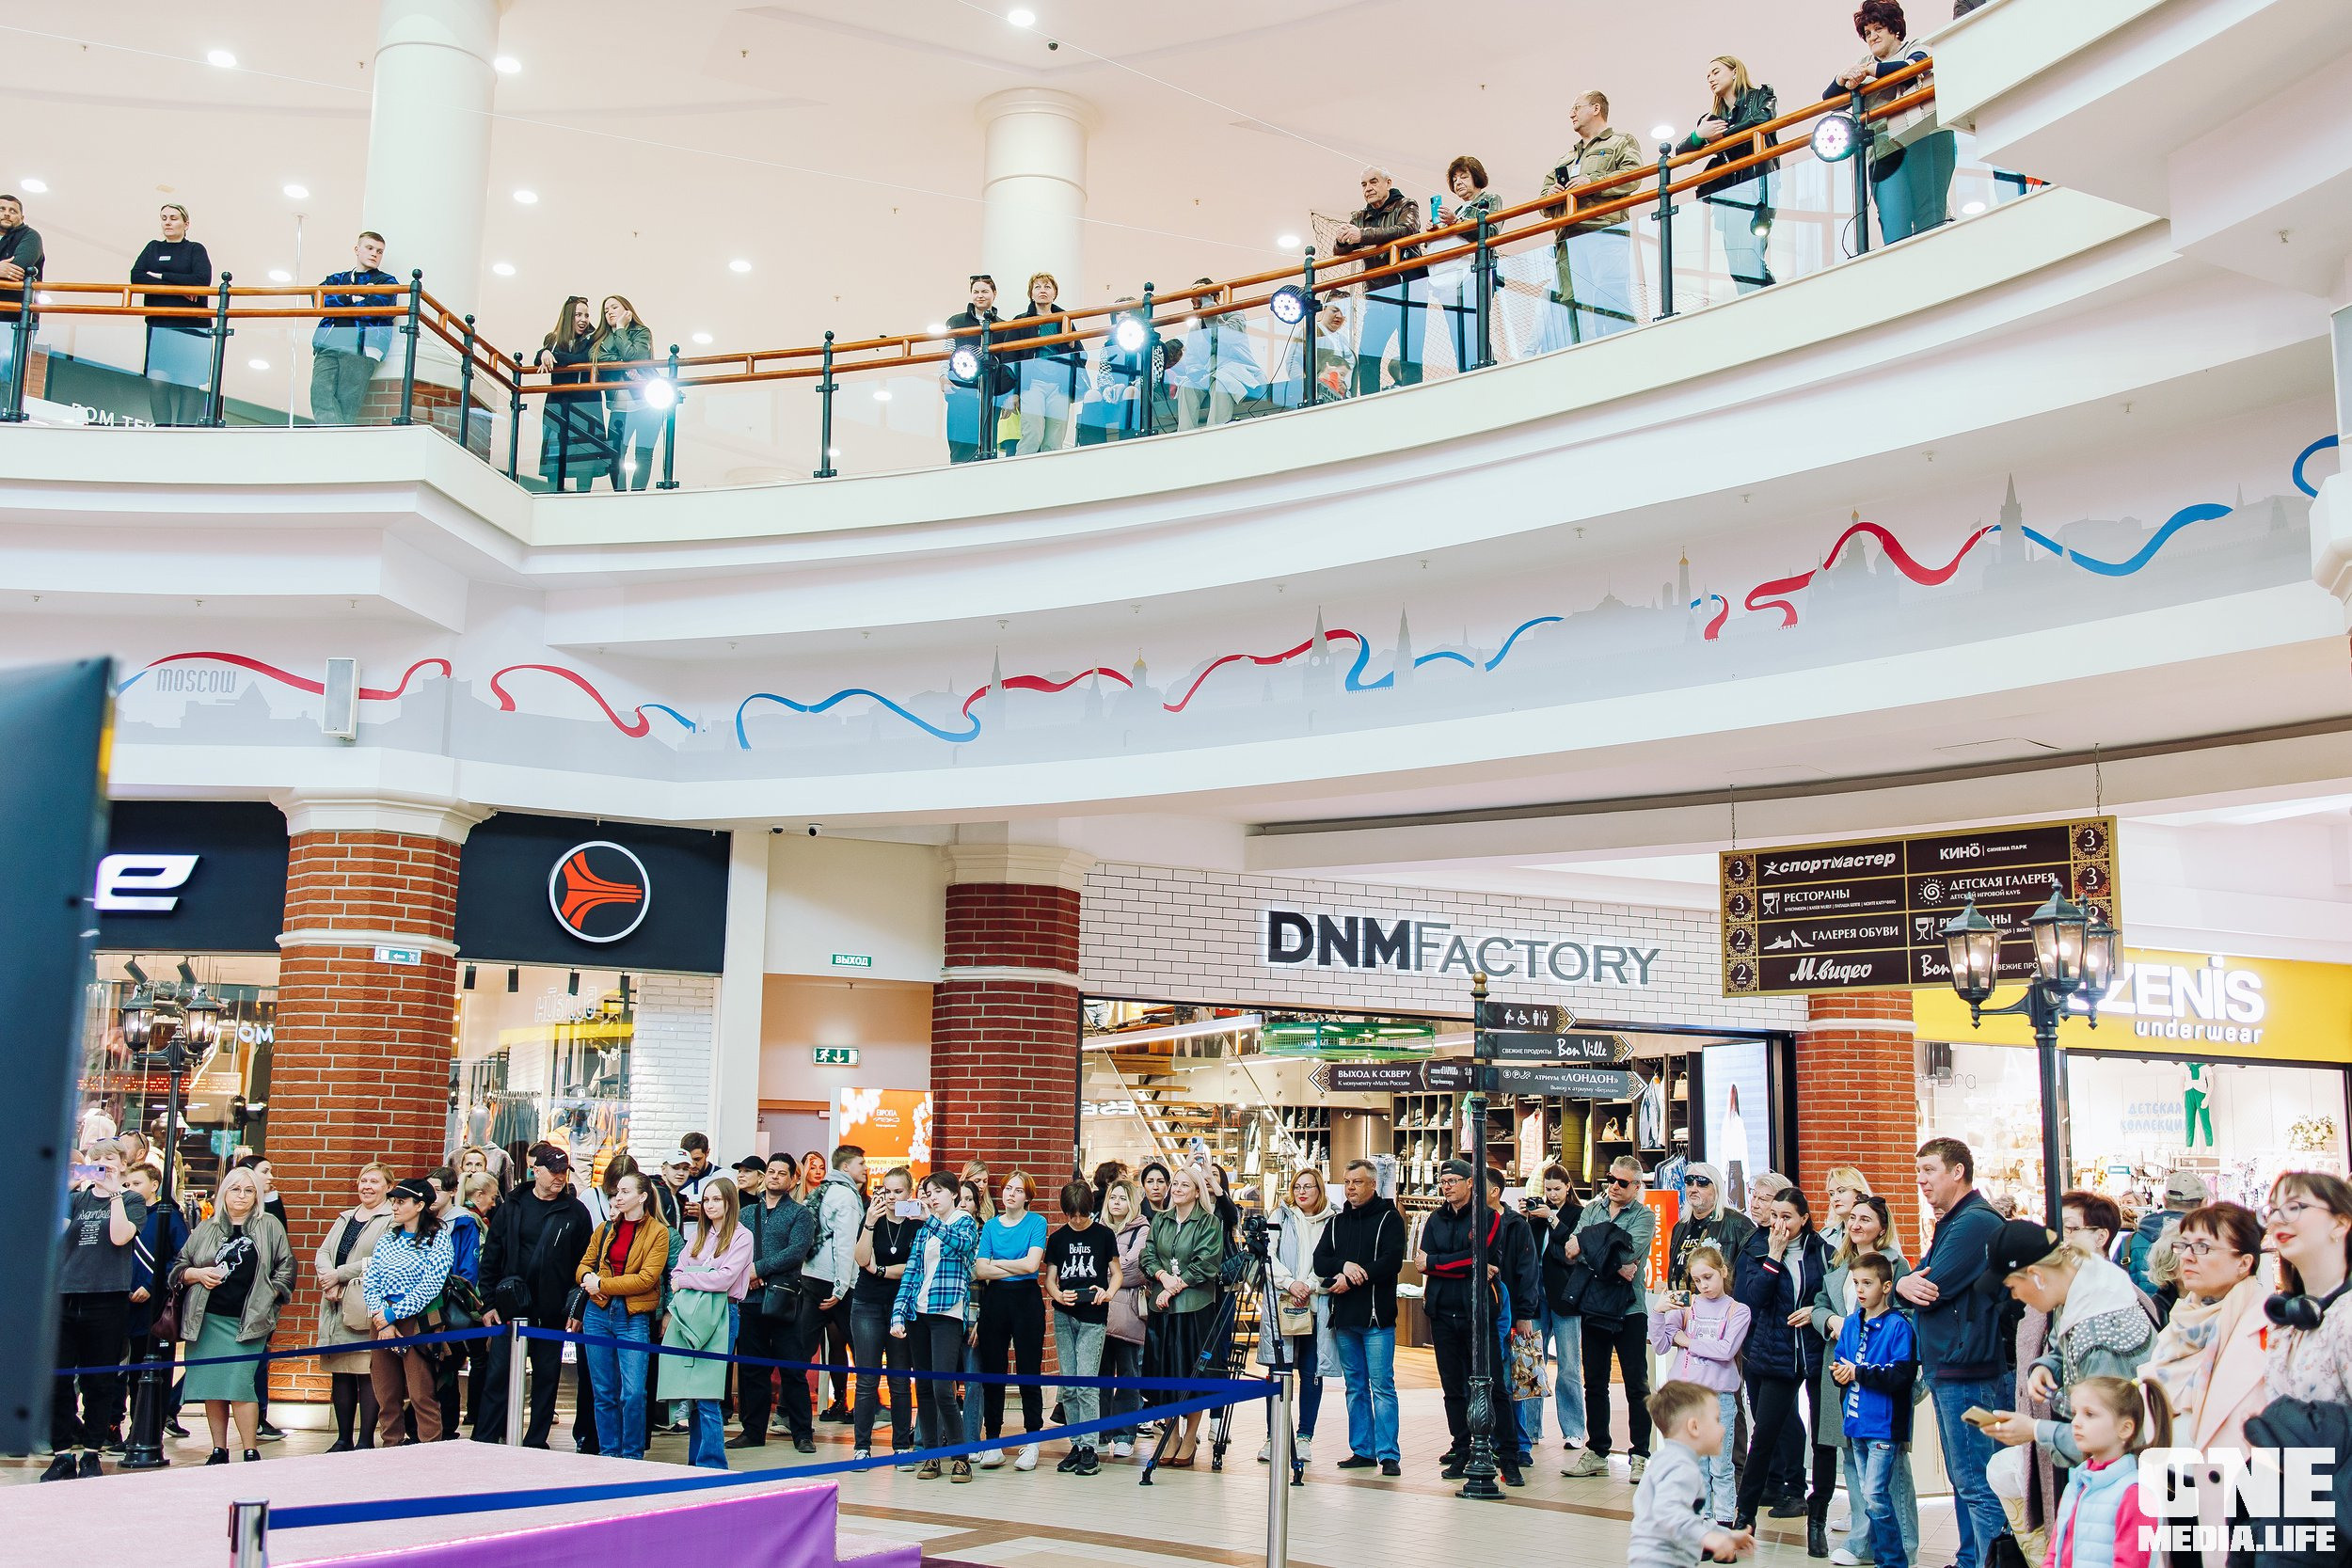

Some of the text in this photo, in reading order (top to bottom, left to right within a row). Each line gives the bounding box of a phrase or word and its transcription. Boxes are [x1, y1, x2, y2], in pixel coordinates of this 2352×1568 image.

[156, 668, 237, 693] MOSCOW
[2084, 829, 2095, 847] 3
[1734, 861, 1744, 877] 3
[2086, 867, 2097, 885] 3
[1949, 872, 2056, 891] ДЕТСКАЯ ГАЛЕРЕЯ
[1735, 895, 1744, 911] 3
[1784, 889, 1851, 903] РЕСТОРАНЫ
[1736, 929, 1745, 945] 2
[1812, 926, 1899, 941] ГАЛЕРЕЯ ОБУВИ
[835, 955, 868, 967] ВЫХОД
[1997, 962, 2022, 971] ВЕЖИЕ
[1737, 963, 1746, 980] 2
[2135, 1019, 2265, 1045] underwear
[1557, 1037, 1581, 1057] Bon
[1582, 1038, 1608, 1057] Ville
[1338, 1069, 1412, 1079] ВЫХОД К СКВЕРУ
[1561, 1073, 1619, 1084] «ЛОНДОН»
[2128, 1101, 2183, 1115] ДЕТСКАЯ
[2121, 1118, 2185, 1132] КОЛЛЕКЦИ
